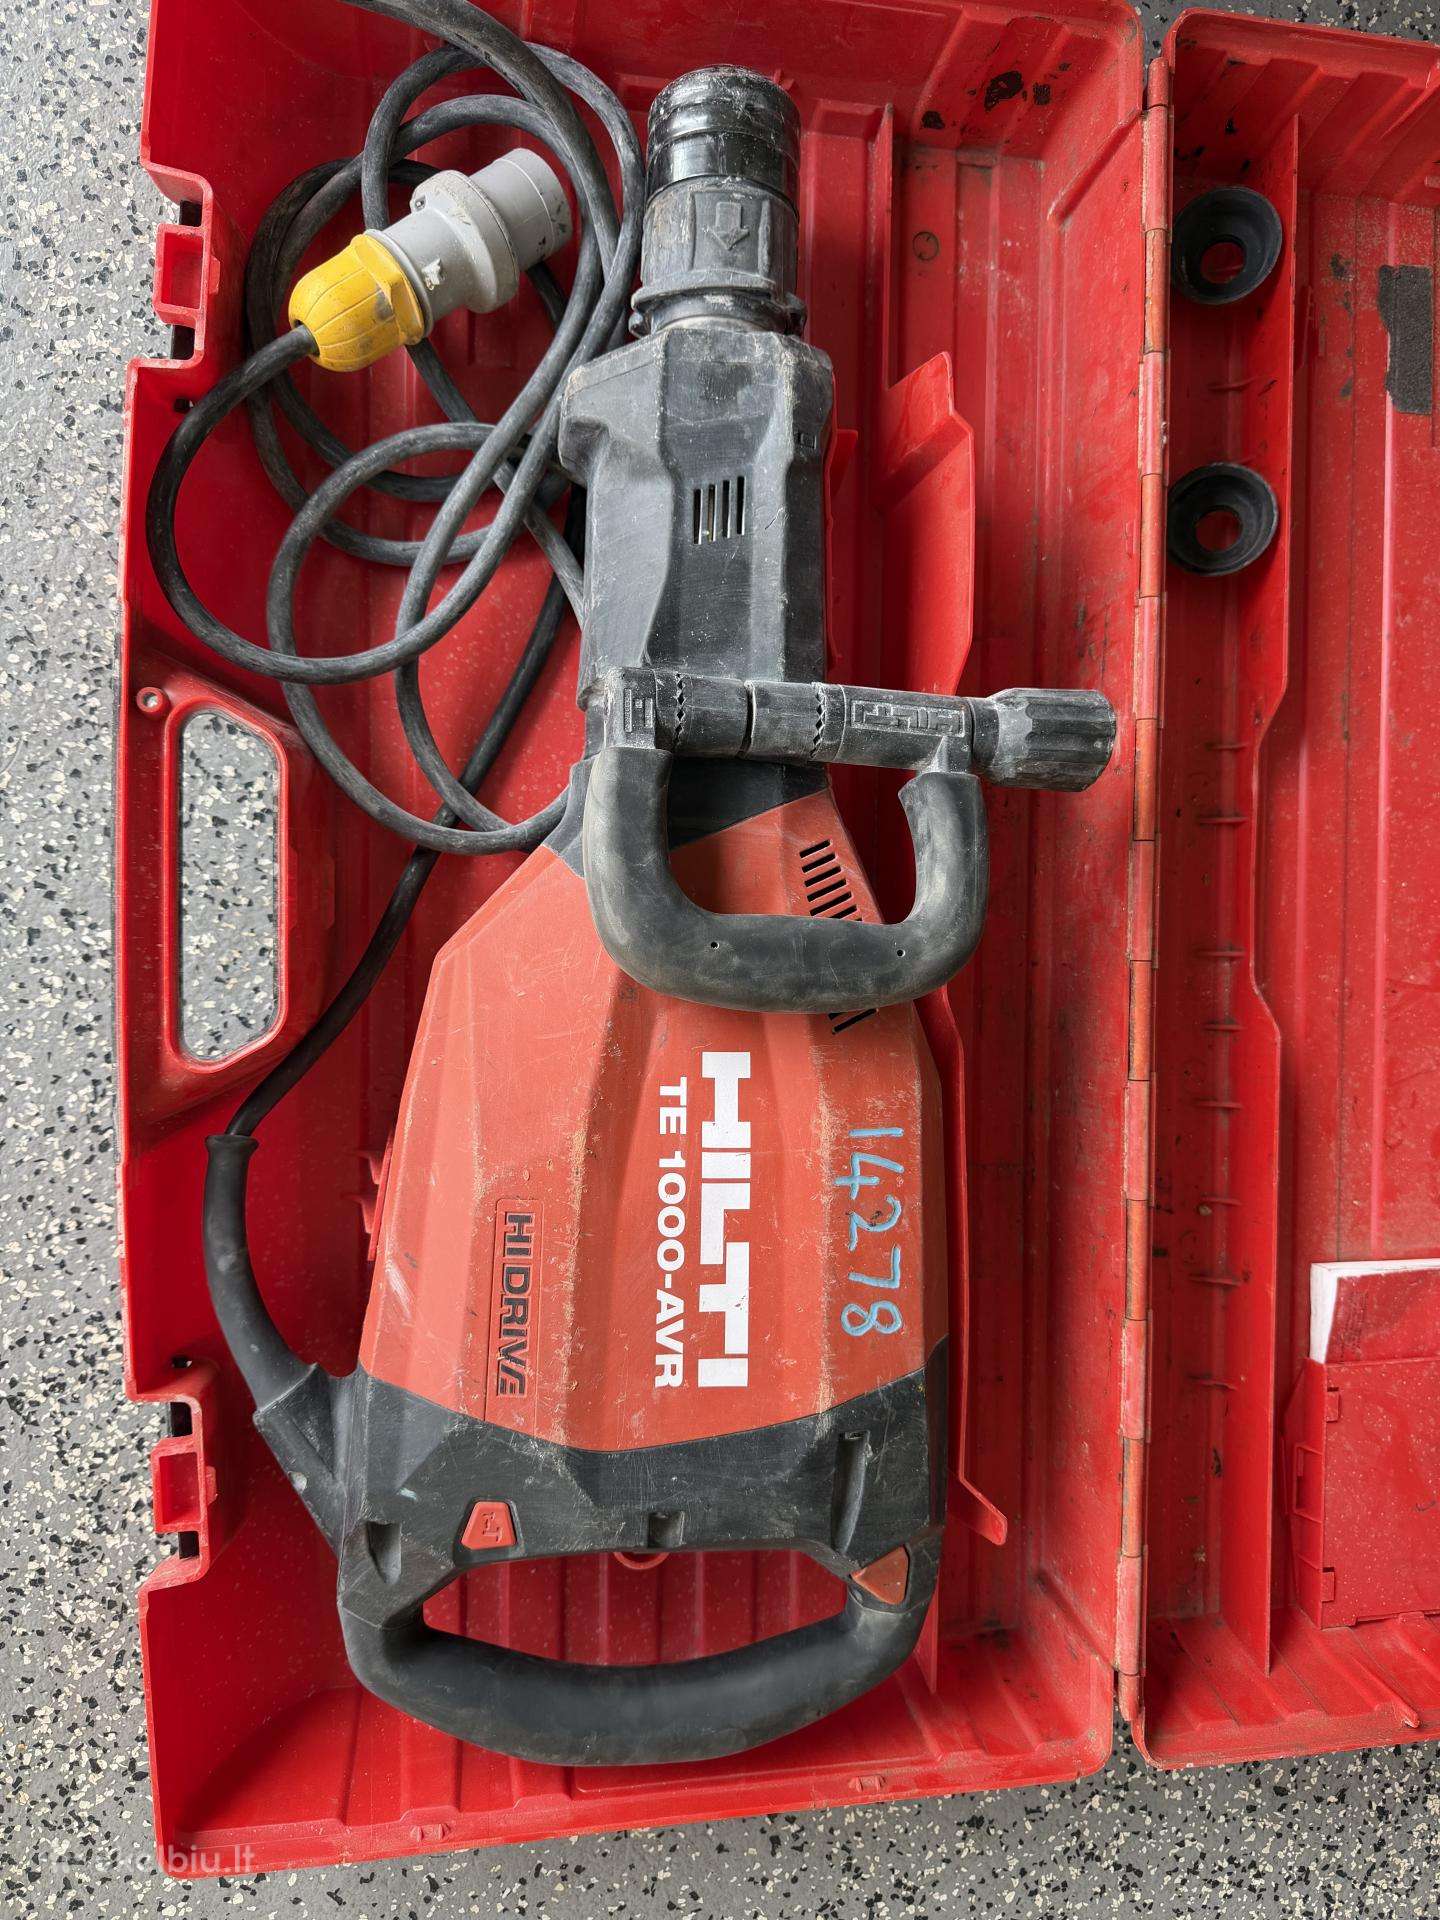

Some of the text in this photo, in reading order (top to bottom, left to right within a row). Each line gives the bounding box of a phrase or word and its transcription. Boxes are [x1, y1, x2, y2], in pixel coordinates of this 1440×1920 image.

[654, 1076, 687, 1389] TE 1000-AVR
[698, 1051, 751, 1388] HILTI
[833, 1127, 905, 1336] 14278
